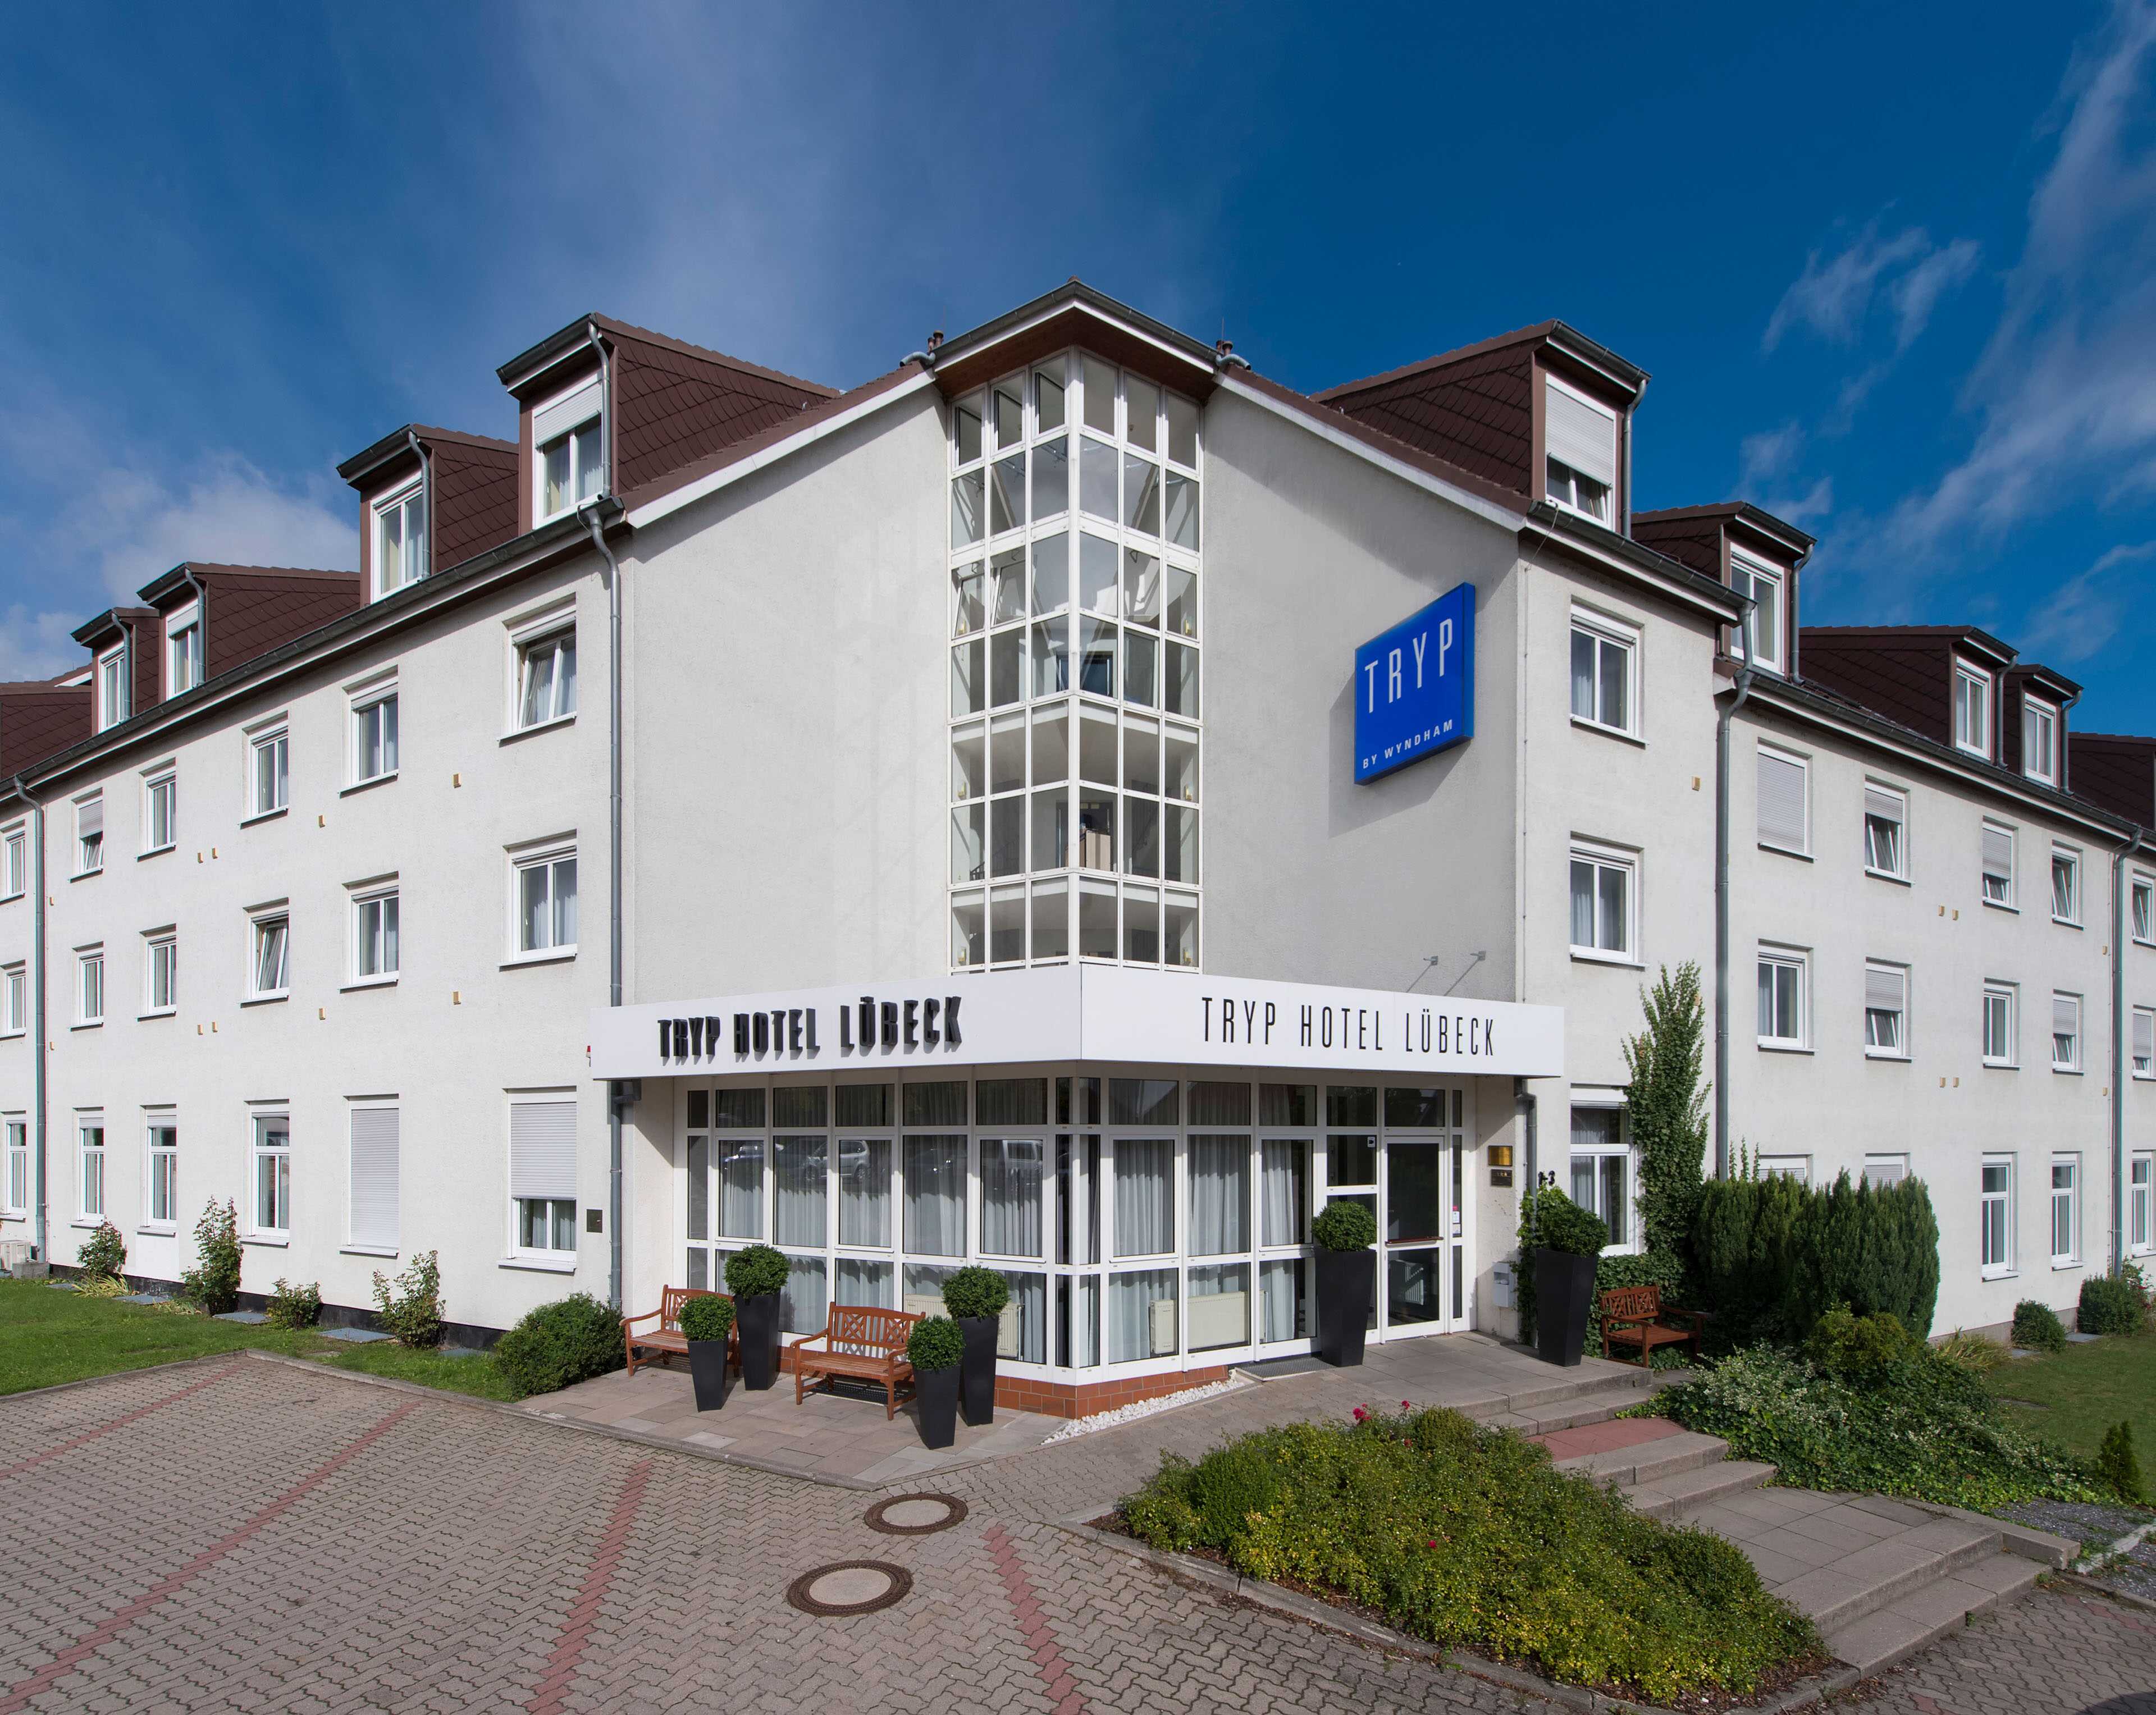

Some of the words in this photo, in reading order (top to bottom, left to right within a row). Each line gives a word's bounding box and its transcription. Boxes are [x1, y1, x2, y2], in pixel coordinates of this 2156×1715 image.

[1364, 618, 1452, 714] TRYP
[1363, 753, 1377, 769] BY
[1385, 719, 1452, 758] WYNDHAM
[657, 1016, 720, 1058] TRYP
[733, 1008, 820, 1053] HOTEL
[841, 996, 962, 1048] LÜBECK
[1202, 997, 1276, 1045] TRYP
[1300, 1004, 1383, 1051] HOTEL
[1406, 1008, 1494, 1056] LÜBECK
